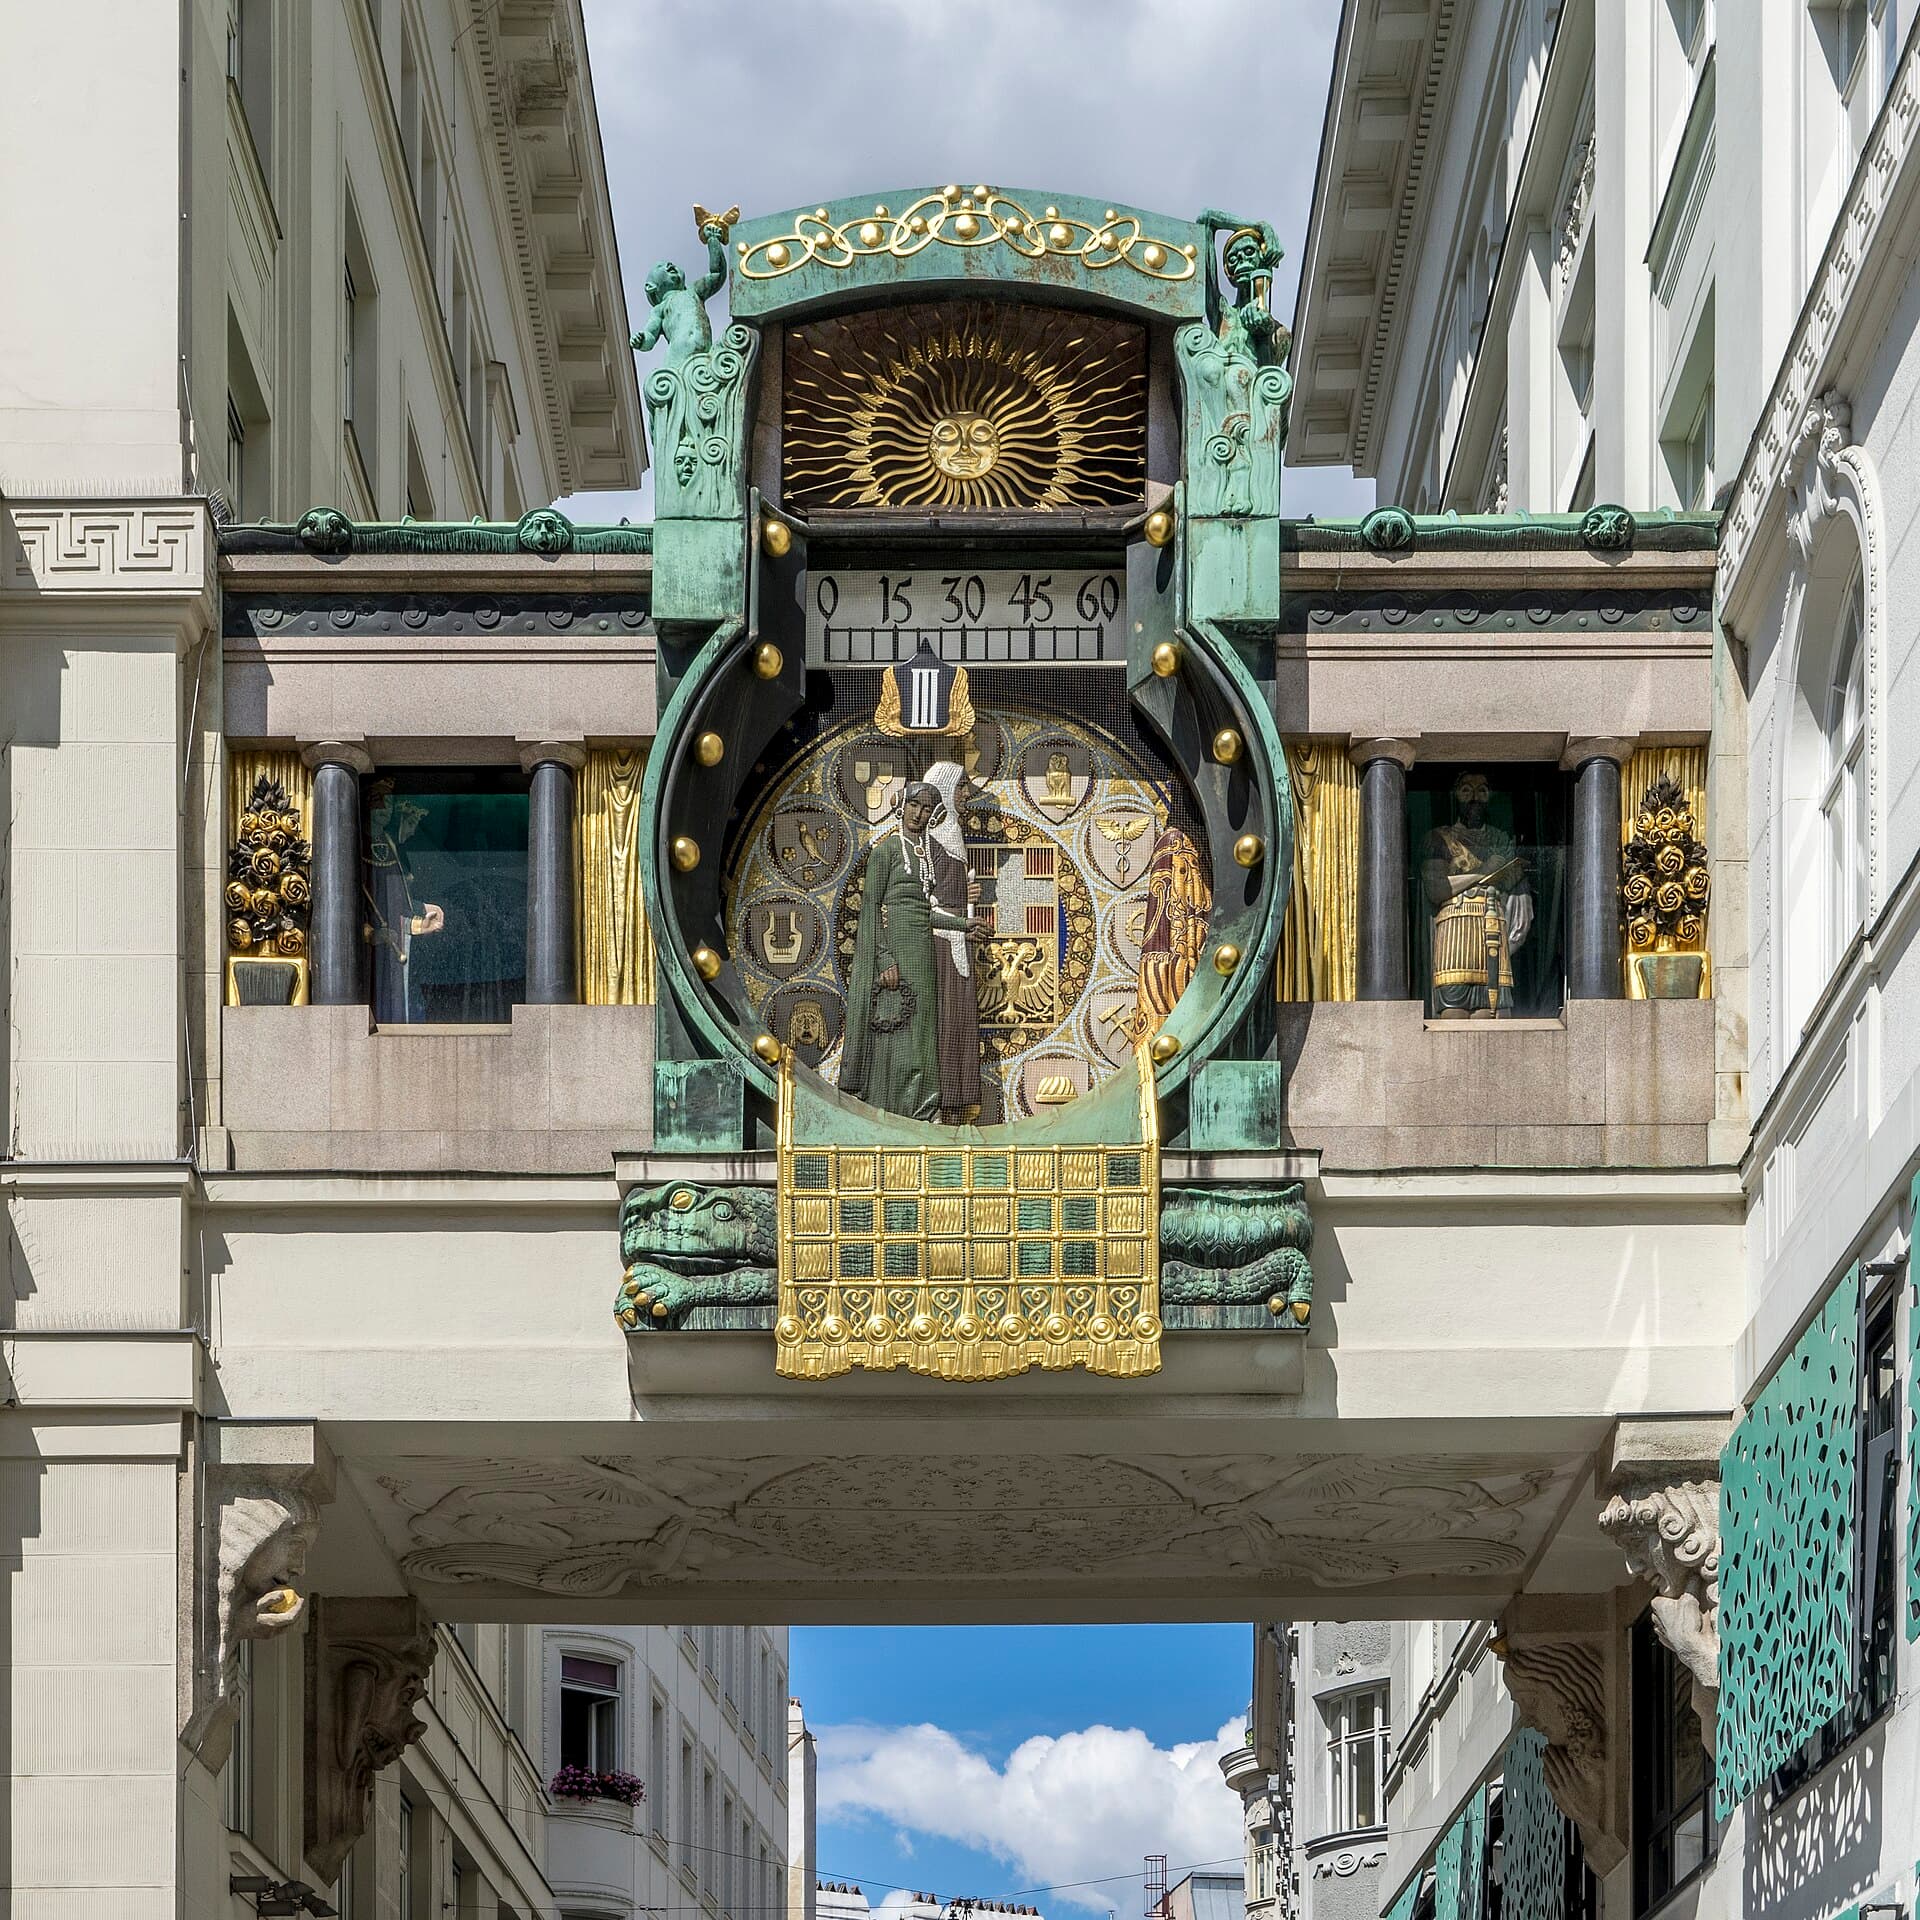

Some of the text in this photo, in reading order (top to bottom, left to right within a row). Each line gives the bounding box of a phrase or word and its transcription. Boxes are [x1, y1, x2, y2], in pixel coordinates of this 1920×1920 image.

[817, 575, 1119, 624] 0 15 30 45 60
[910, 668, 940, 728] III
